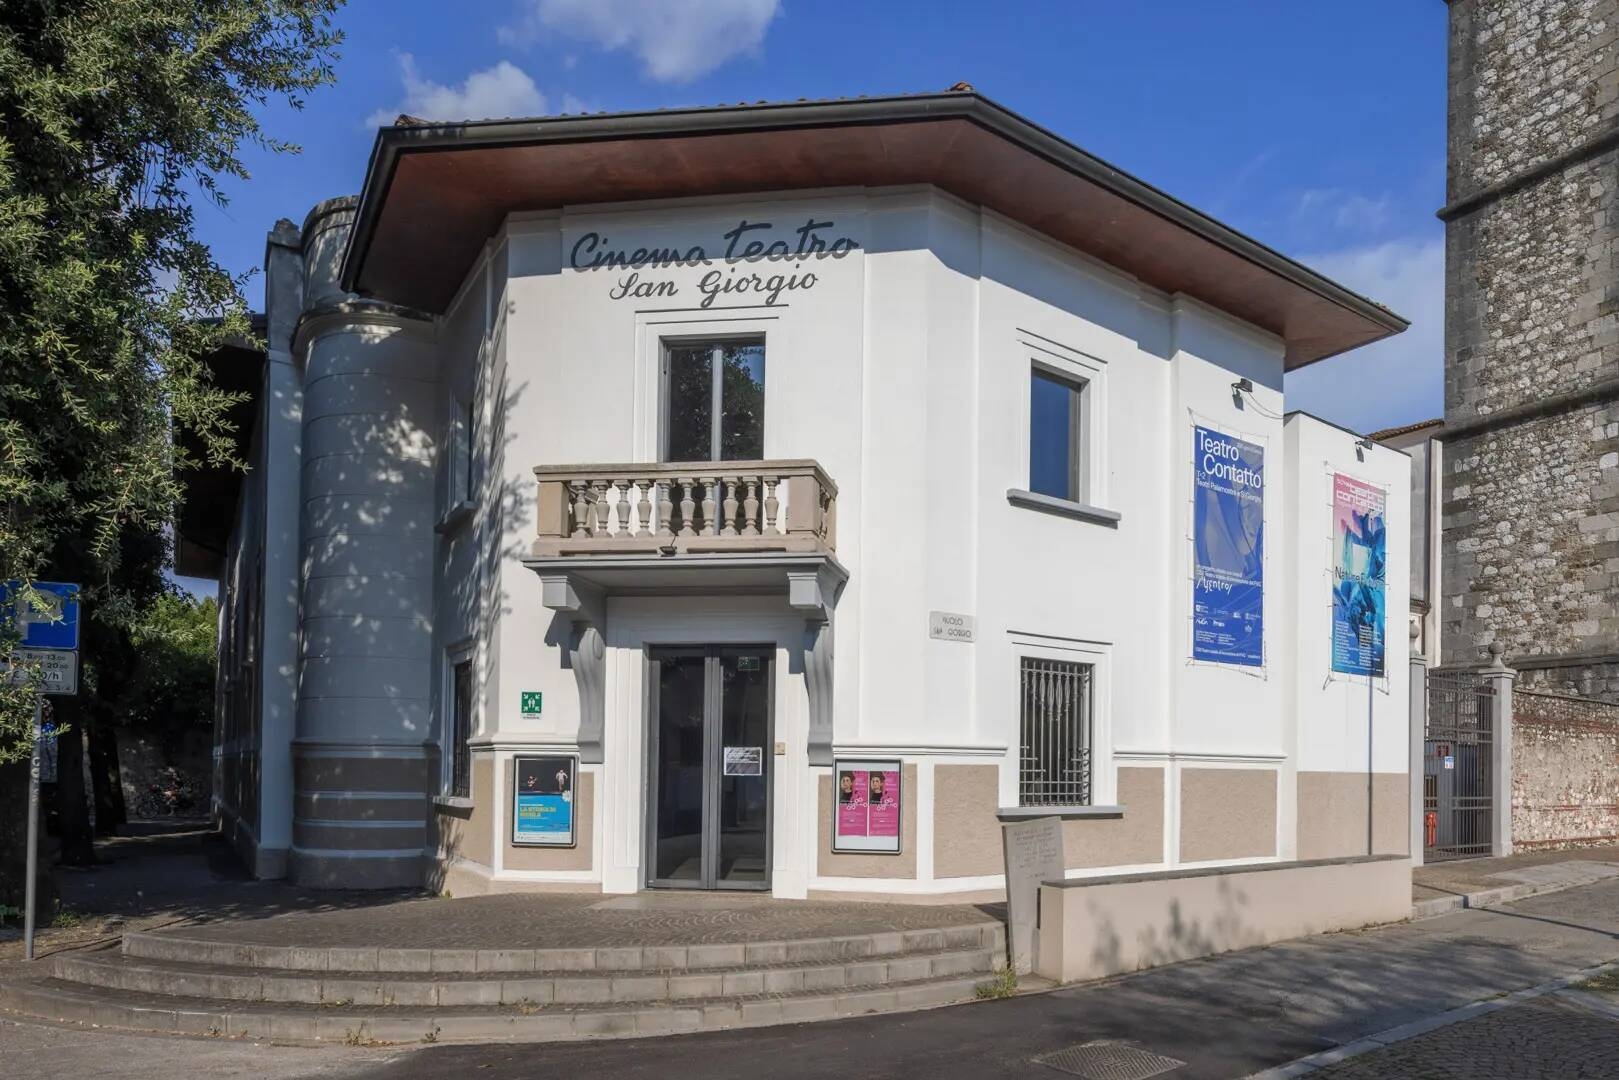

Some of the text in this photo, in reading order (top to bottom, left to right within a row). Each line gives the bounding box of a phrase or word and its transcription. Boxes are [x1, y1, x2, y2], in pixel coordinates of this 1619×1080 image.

[570, 219, 859, 272] Cinema Teatro
[610, 263, 818, 308] San Giorgio
[1197, 429, 1239, 461] Teatro
[1203, 454, 1262, 489] Contatto
